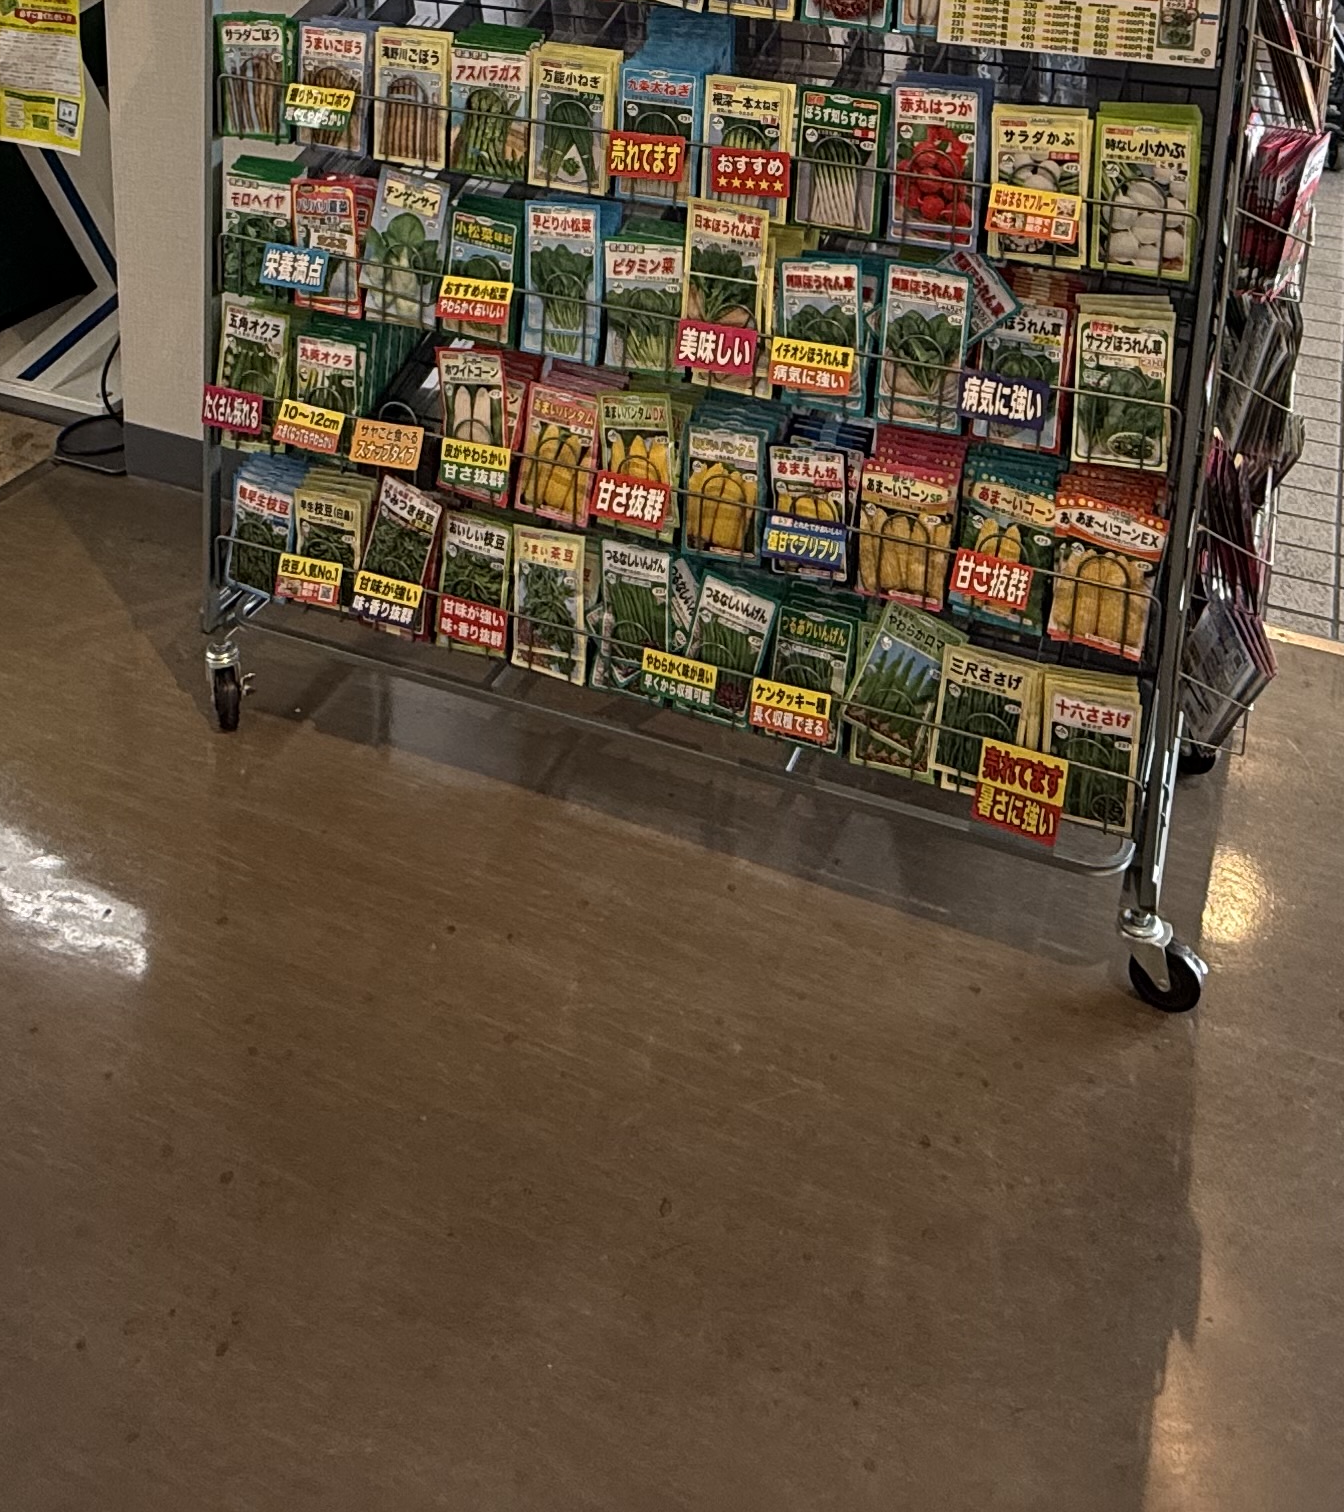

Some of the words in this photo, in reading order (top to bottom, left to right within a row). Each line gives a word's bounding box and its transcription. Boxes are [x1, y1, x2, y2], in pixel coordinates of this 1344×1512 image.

[225, 29, 280, 42] サラダごぼう
[304, 36, 363, 56] うまいごぼう
[381, 46, 441, 65] 滝野川ごぼう
[455, 64, 522, 83] アスパラガス
[542, 69, 602, 87] 万能小ねぎ
[627, 79, 691, 98] 九条太ねぎ
[712, 93, 781, 112] 根深一本太ねぎ
[899, 97, 974, 116] 赤丸はつか
[1003, 128, 1076, 146] サラダかぶ
[1104, 137, 1187, 159] 時なし小かぶ
[610, 139, 681, 175] 売れてます
[717, 153, 785, 176] おすすめ
[230, 191, 286, 209] モロヘイヤ
[385, 185, 440, 212] チンゲンサイ
[455, 221, 493, 242] 小松菜
[532, 214, 593, 233] 早どり小松菜
[693, 216, 762, 240] 日本ほうれん草
[263, 250, 325, 287] 栄養満点
[612, 257, 677, 276] ビタミン菜
[442, 281, 510, 301] おすすめ小松菜
[439, 297, 505, 319] やわらかくおいしい
[228, 313, 281, 338] 五角オクラ
[678, 326, 752, 365] 美味しい
[774, 340, 851, 369] イチオシほうれん草
[1085, 333, 1164, 357] サラダほうれん草
[444, 363, 500, 378] ホワイトコーン
[772, 365, 845, 389] 病気に強い
[203, 393, 260, 428] たくさん採れる
[532, 397, 594, 426] あまいバンタム
[962, 376, 1042, 421] 病気に強い
[281, 403, 340, 432] 10〜12cm
[360, 425, 419, 444] サヤごと食べる
[354, 441, 416, 463] スナップタイプ
[443, 442, 508, 466] 皮がやわらかい
[443, 463, 506, 489] 甘さ抜群
[776, 460, 838, 479] あまえん坊
[595, 477, 667, 523] 甘さ抜群
[866, 476, 943, 505] あま〜いコーンSP
[977, 484, 1056, 523] あま〜いコーン
[382, 491, 435, 527] やみつき枝豆
[447, 519, 506, 550] おいしい枝豆
[1074, 512, 1159, 549] あま〜いコーンEX
[522, 542, 574, 564] うまい茶豆
[604, 547, 667, 575] つるなしいんげん
[280, 557, 340, 585] 枝豆人気No.1
[956, 553, 1031, 604] 甘さ抜群
[358, 574, 419, 604] 甘味が強い
[352, 596, 414, 625] 味・香り抜群
[442, 597, 505, 628] 甘味が強い
[705, 585, 768, 626] つるなしいんげん
[440, 617, 503, 648] 味・香り抜群
[645, 652, 714, 685] やわらかく味が良い
[949, 656, 1024, 691] 三尺ささげ
[755, 682, 828, 716] ケンタッキー種
[753, 706, 825, 737] 長く収穫できる
[1055, 699, 1132, 730] 十六ささげ
[982, 745, 1065, 799] 売れてます
[976, 786, 1055, 836] 暑さに強い
